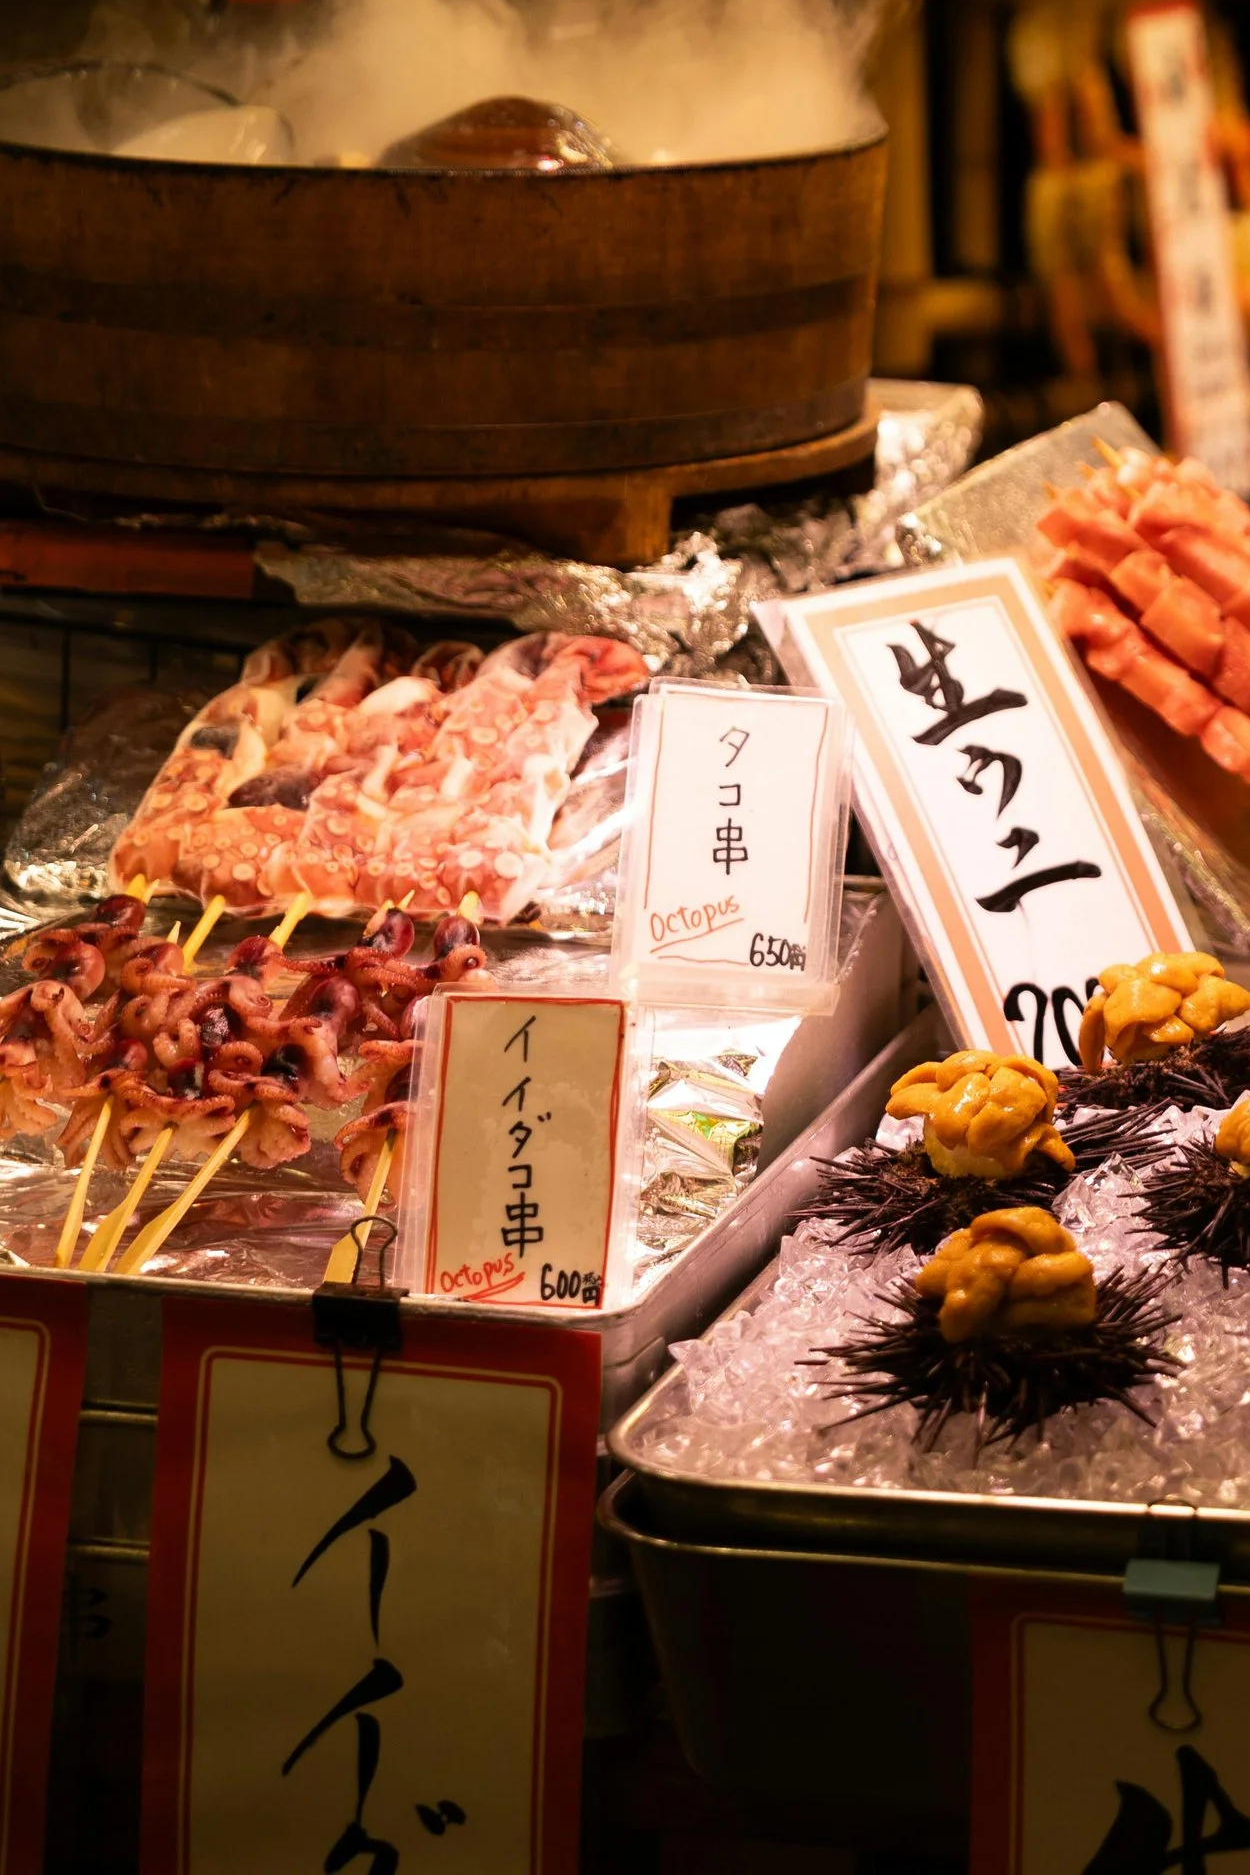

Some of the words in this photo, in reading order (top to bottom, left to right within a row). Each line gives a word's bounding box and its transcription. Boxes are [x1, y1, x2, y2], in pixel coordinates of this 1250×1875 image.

[713, 726, 750, 876] タコ串
[885, 619, 1102, 913] 生ウニ
[650, 895, 740, 942] Octopus
[1003, 976, 1105, 1067] 20
[500, 1014, 553, 1259] イイダコ串
[440, 1252, 515, 1292] Octopus
